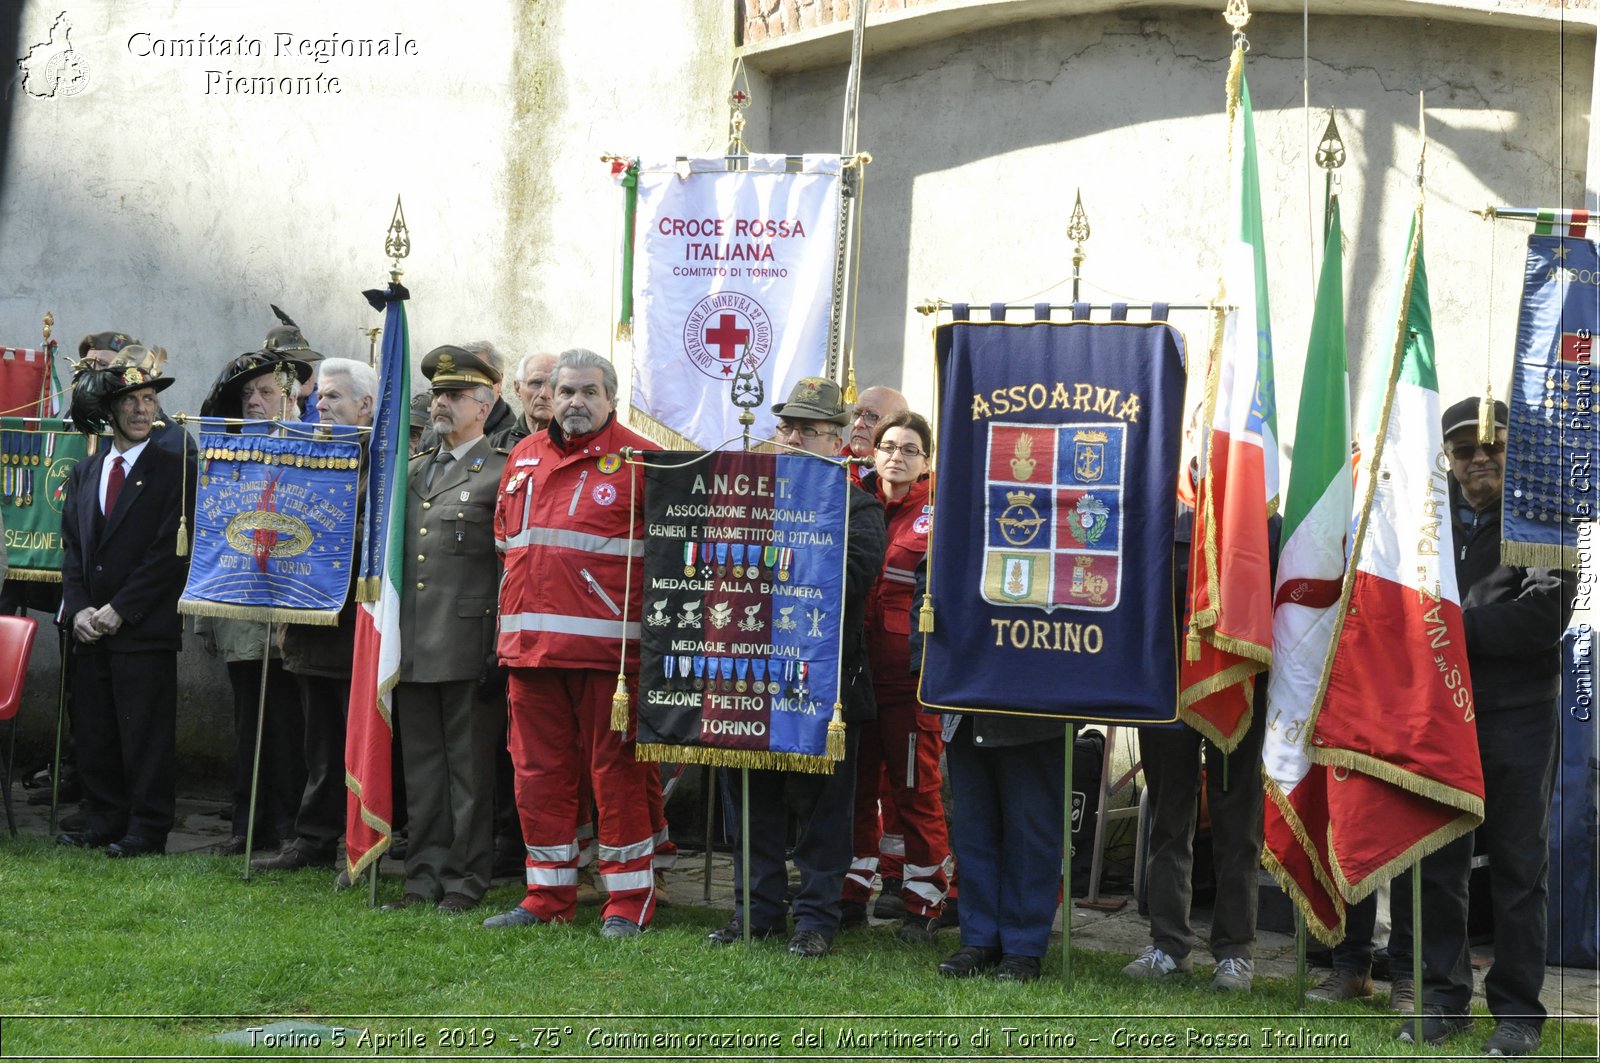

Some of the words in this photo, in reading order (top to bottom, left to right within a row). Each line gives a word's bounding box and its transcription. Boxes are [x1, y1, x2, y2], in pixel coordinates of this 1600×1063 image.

[658, 217, 725, 238] CROCE
[735, 219, 806, 239] ROSSA
[685, 243, 775, 262] ITALIANA
[672, 266, 727, 277] COMITATO
[730, 267, 741, 277] DI
[746, 268, 788, 278] TORINO
[700, 301, 712, 314] DI
[711, 295, 751, 313] GINEVRA
[749, 308, 762, 320] 22
[686, 311, 713, 369] CONVENZIONE
[754, 321, 769, 354] AGOSTO
[971, 382, 1141, 422] ASSOARMA
[691, 474, 792, 499] A.N.G.E.T.
[284, 497, 337, 531] LIBERAZIONE
[666, 504, 746, 519] ASSOCIAZIONE
[752, 507, 816, 523] NAZIONALE
[4, 529, 57, 549] SEZIONE
[649, 524, 686, 538] GENIERI
[691, 525, 698, 538] E
[702, 526, 784, 542] TRASMETTITORI
[789, 531, 833, 545] D'ITALIA
[218, 554, 238, 570] SEDE
[242, 556, 251, 570] DI
[275, 560, 312, 576] TORINO
[652, 577, 715, 592] MEDAGLIE
[720, 580, 753, 594] ALLA
[760, 583, 823, 600] BANDIERA
[991, 618, 1104, 654] TORINO
[671, 639, 726, 653] MEDAGLIE
[731, 643, 800, 658] INDIVIDUALI
[647, 690, 702, 707] SEZIONE
[707, 694, 764, 711] "PIETRO
[771, 698, 823, 716] MICCA"
[701, 718, 766, 736] TORINO
